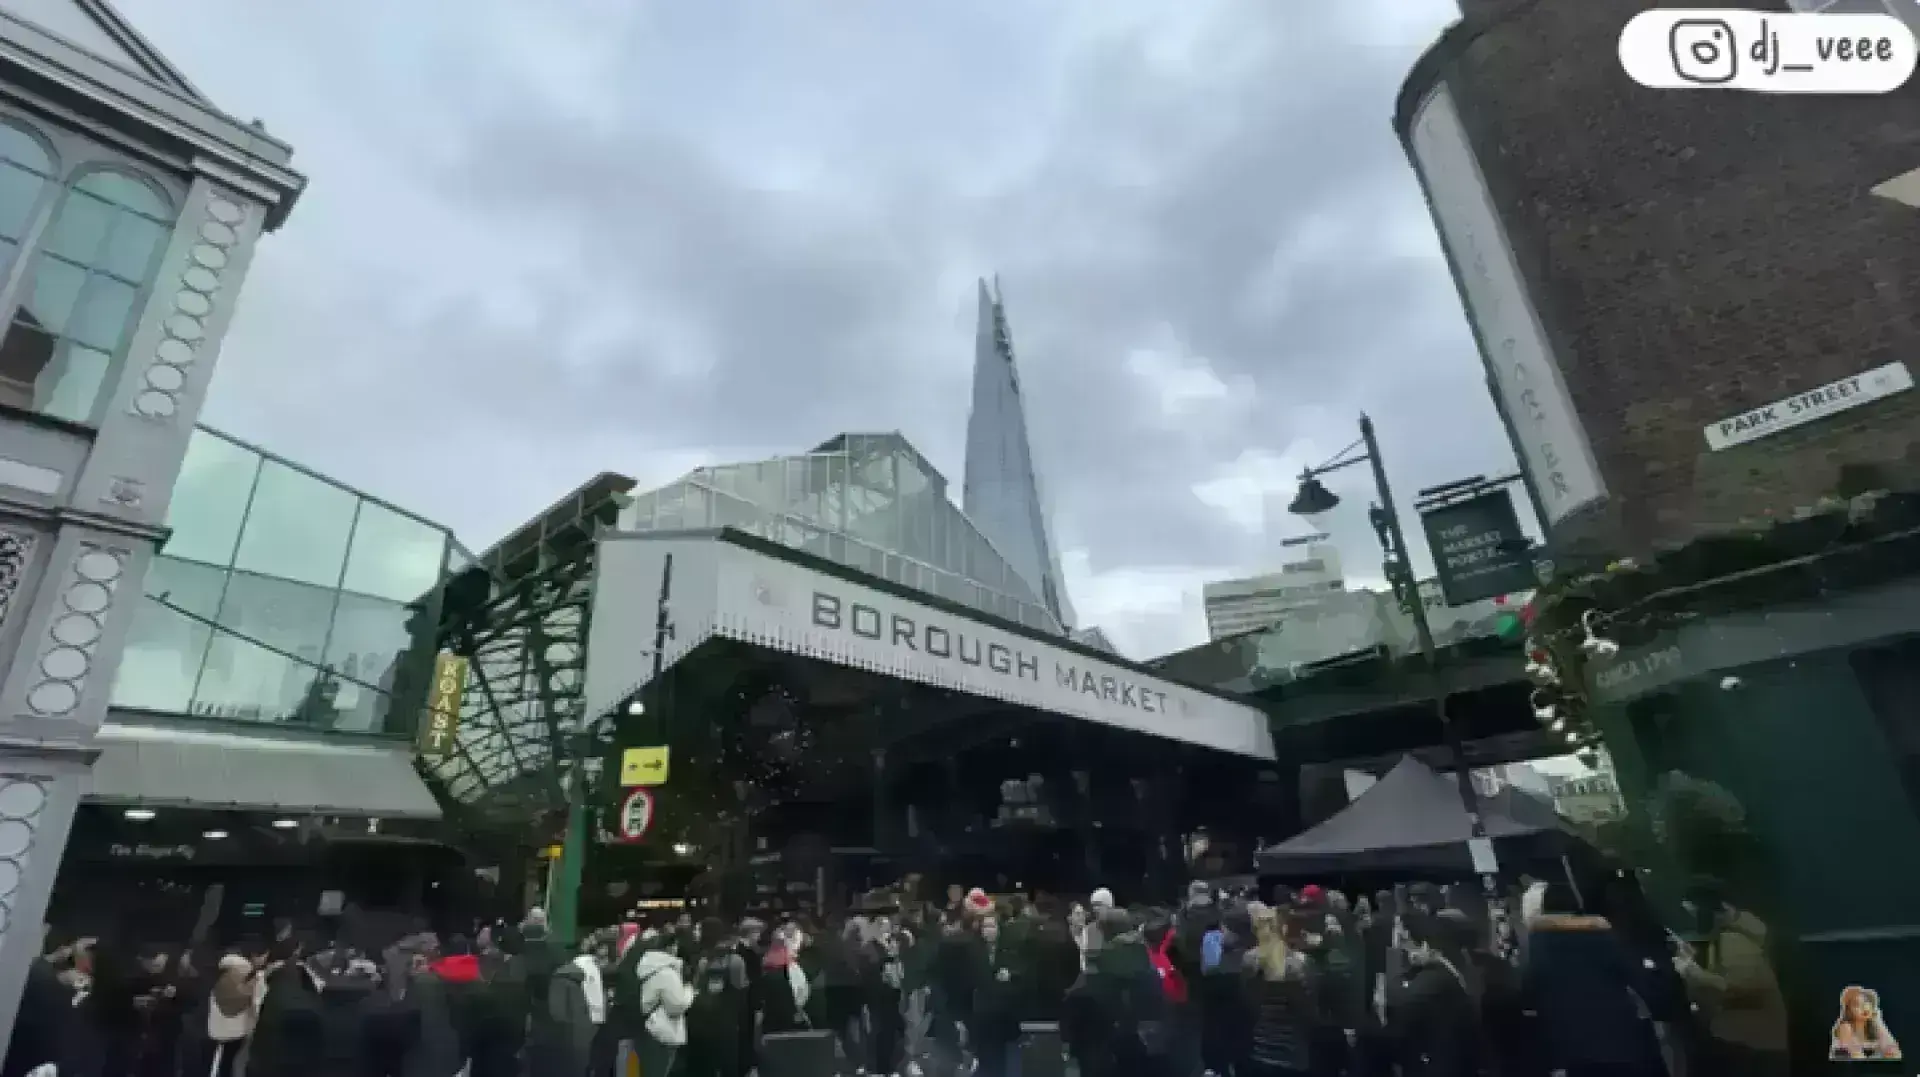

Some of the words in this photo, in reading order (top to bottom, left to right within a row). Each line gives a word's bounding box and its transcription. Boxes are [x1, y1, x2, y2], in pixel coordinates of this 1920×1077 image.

[1720, 407, 1779, 437] PARK
[1786, 378, 1861, 414] STREET
[812, 591, 1040, 682] BOROUGH
[1055, 661, 1168, 715] MARKET
[429, 660, 457, 748] ROAST
